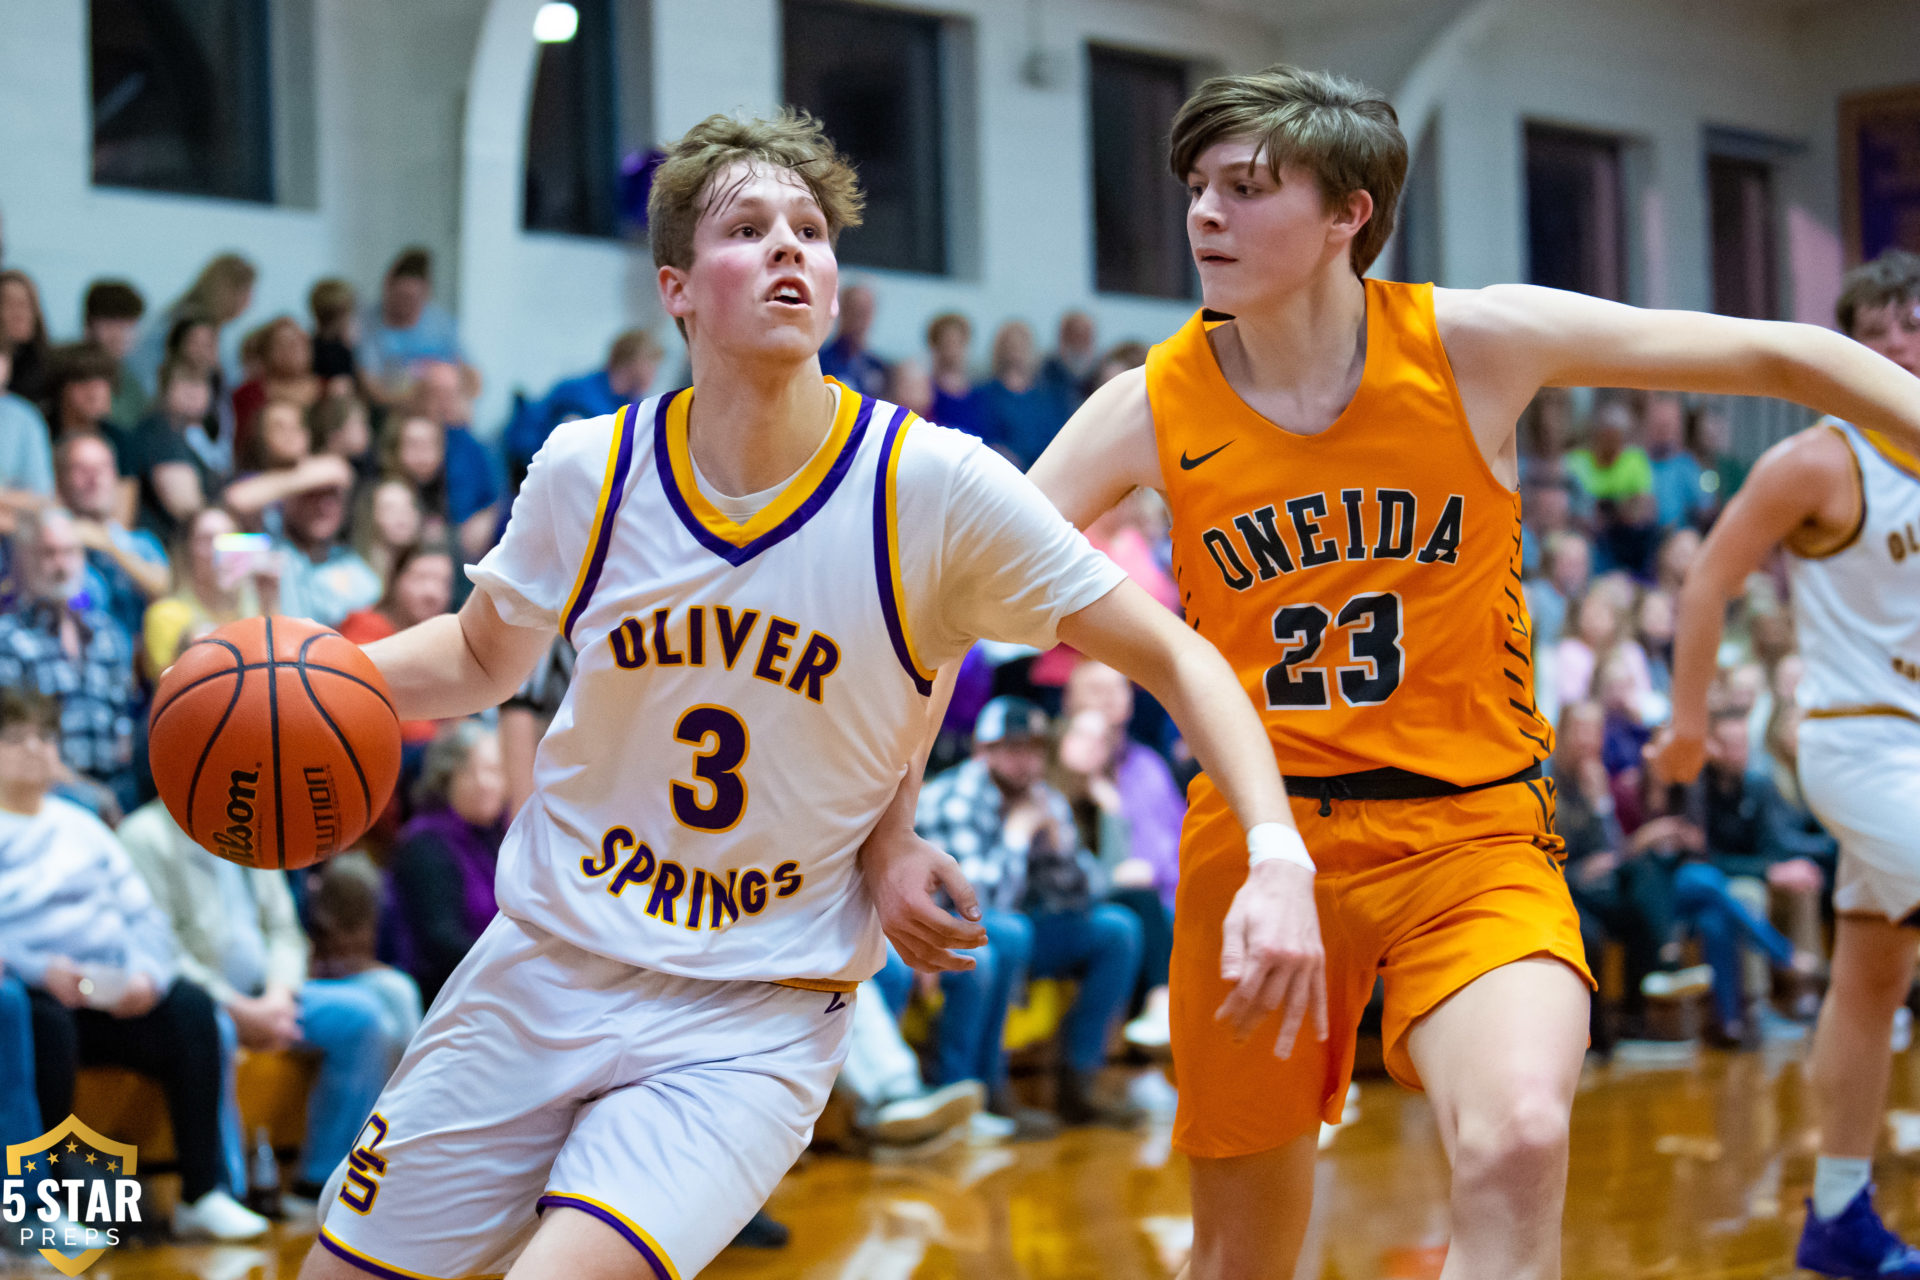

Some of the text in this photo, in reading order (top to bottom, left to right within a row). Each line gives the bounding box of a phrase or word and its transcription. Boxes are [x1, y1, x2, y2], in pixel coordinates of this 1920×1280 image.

[1202, 487, 1465, 592] ONEIDA
[608, 604, 842, 705] OLIVER
[1262, 590, 1406, 711] 23
[213, 769, 259, 867] ilson
[669, 703, 750, 834] 3
[580, 825, 804, 931] SPRINGS
